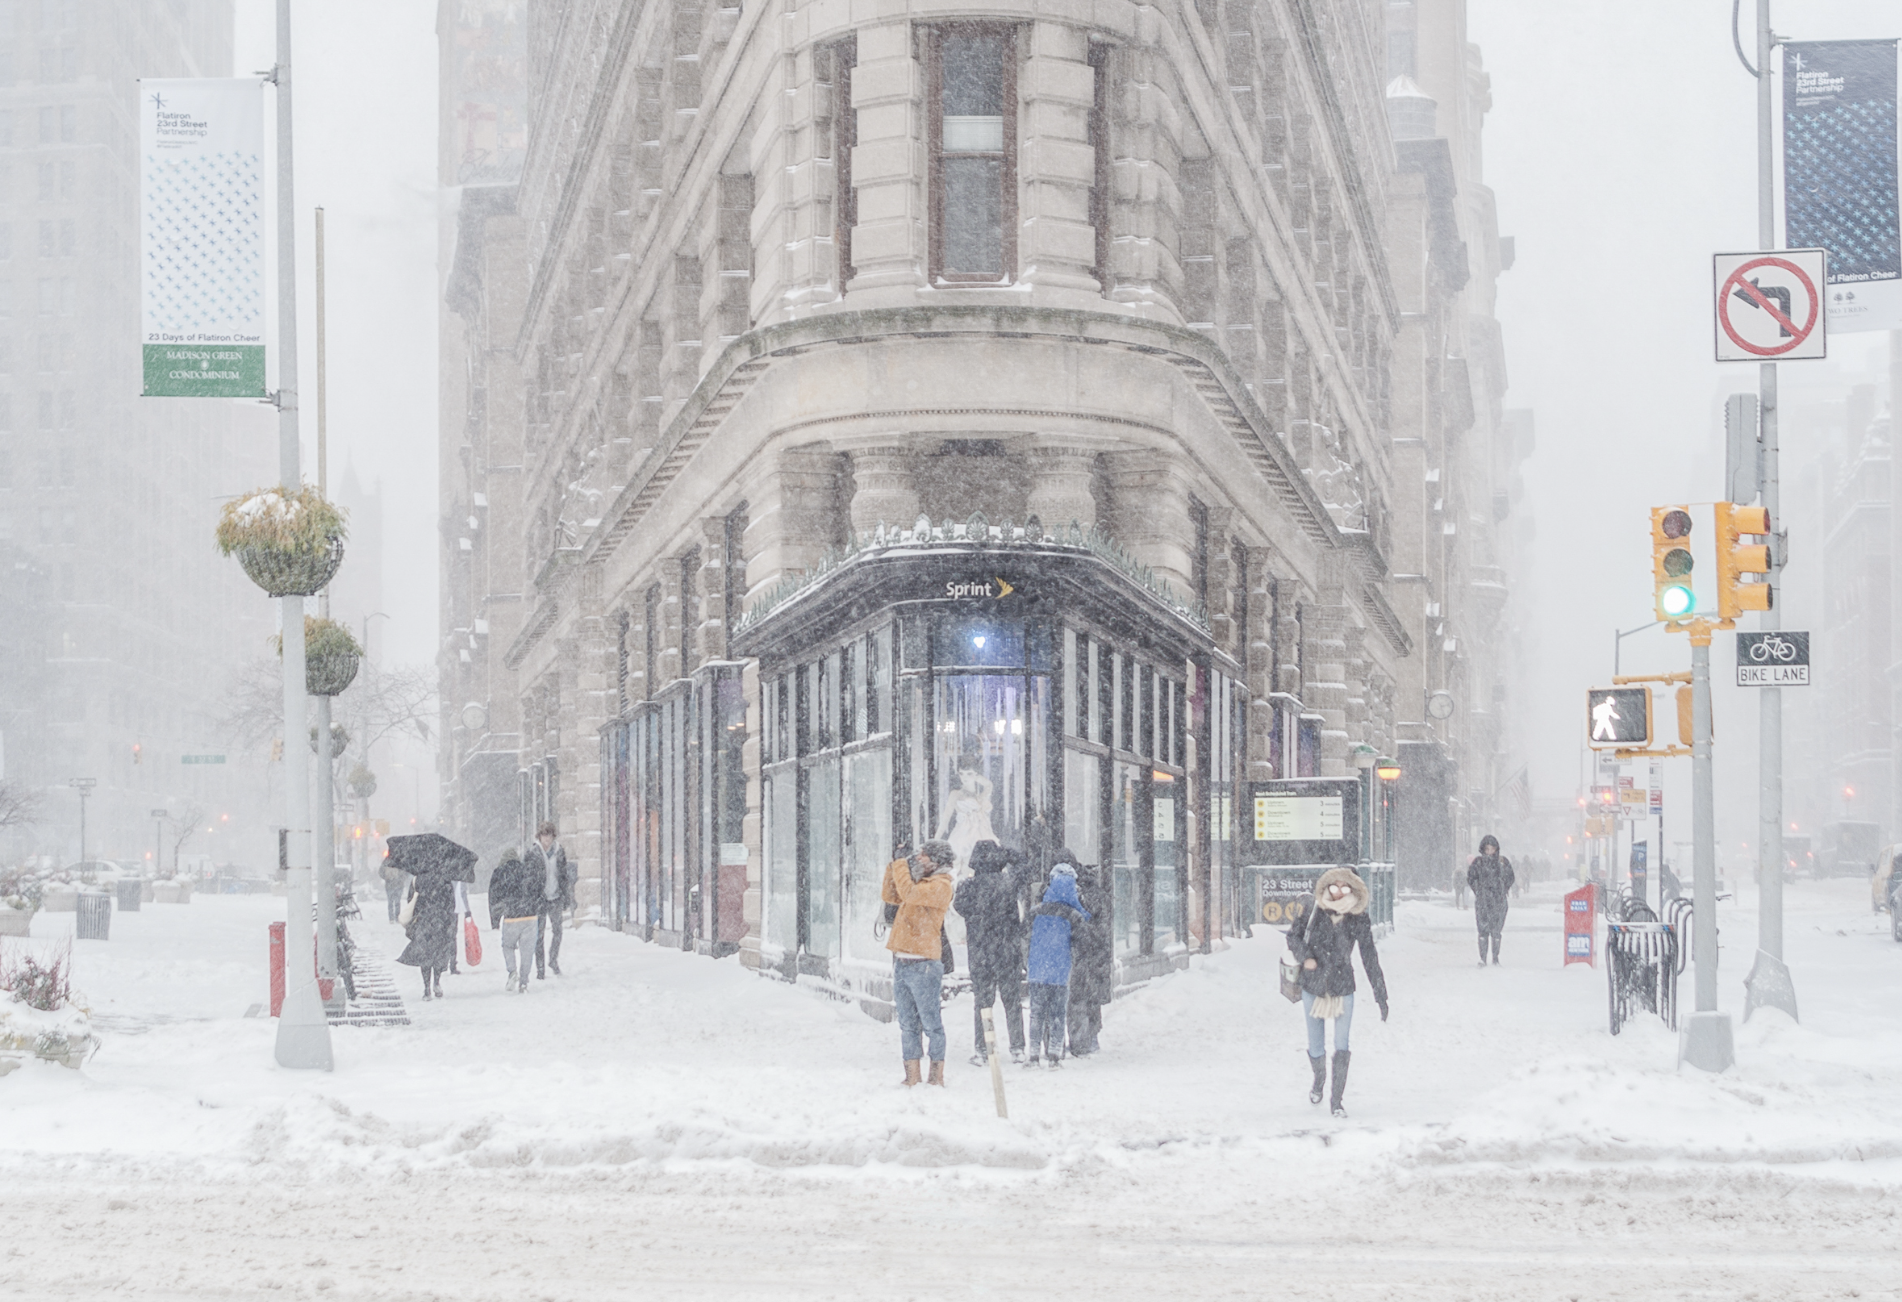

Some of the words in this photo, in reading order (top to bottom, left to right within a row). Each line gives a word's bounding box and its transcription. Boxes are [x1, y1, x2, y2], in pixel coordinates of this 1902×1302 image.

[1796, 71, 1829, 79] Flatiron
[1796, 78, 1817, 87] 23rd
[1817, 76, 1844, 86] Street
[1796, 84, 1844, 94] Partnership
[179, 120, 208, 128] Street
[156, 127, 208, 138] Partnership
[1837, 273, 1869, 282] Flatiron
[1870, 271, 1897, 280] Cheer
[148, 333, 160, 341] 23
[162, 333, 185, 342] Days
[186, 333, 196, 341] of
[198, 333, 231, 342] Flatiron
[233, 334, 261, 342] Cheer
[166, 351, 210, 360] MADISON
[212, 351, 243, 360] GREEN
[168, 370, 240, 380] CONDOMINIUM
[946, 581, 992, 600] Sprint
[1740, 668, 1767, 681] BIKE
[1773, 667, 1807, 681] LANE
[1638, 852, 1645, 861] P
[1262, 879, 1277, 889] 23
[1280, 879, 1313, 889] Street
[1268, 905, 1278, 917] R
[1568, 936, 1590, 948] am
